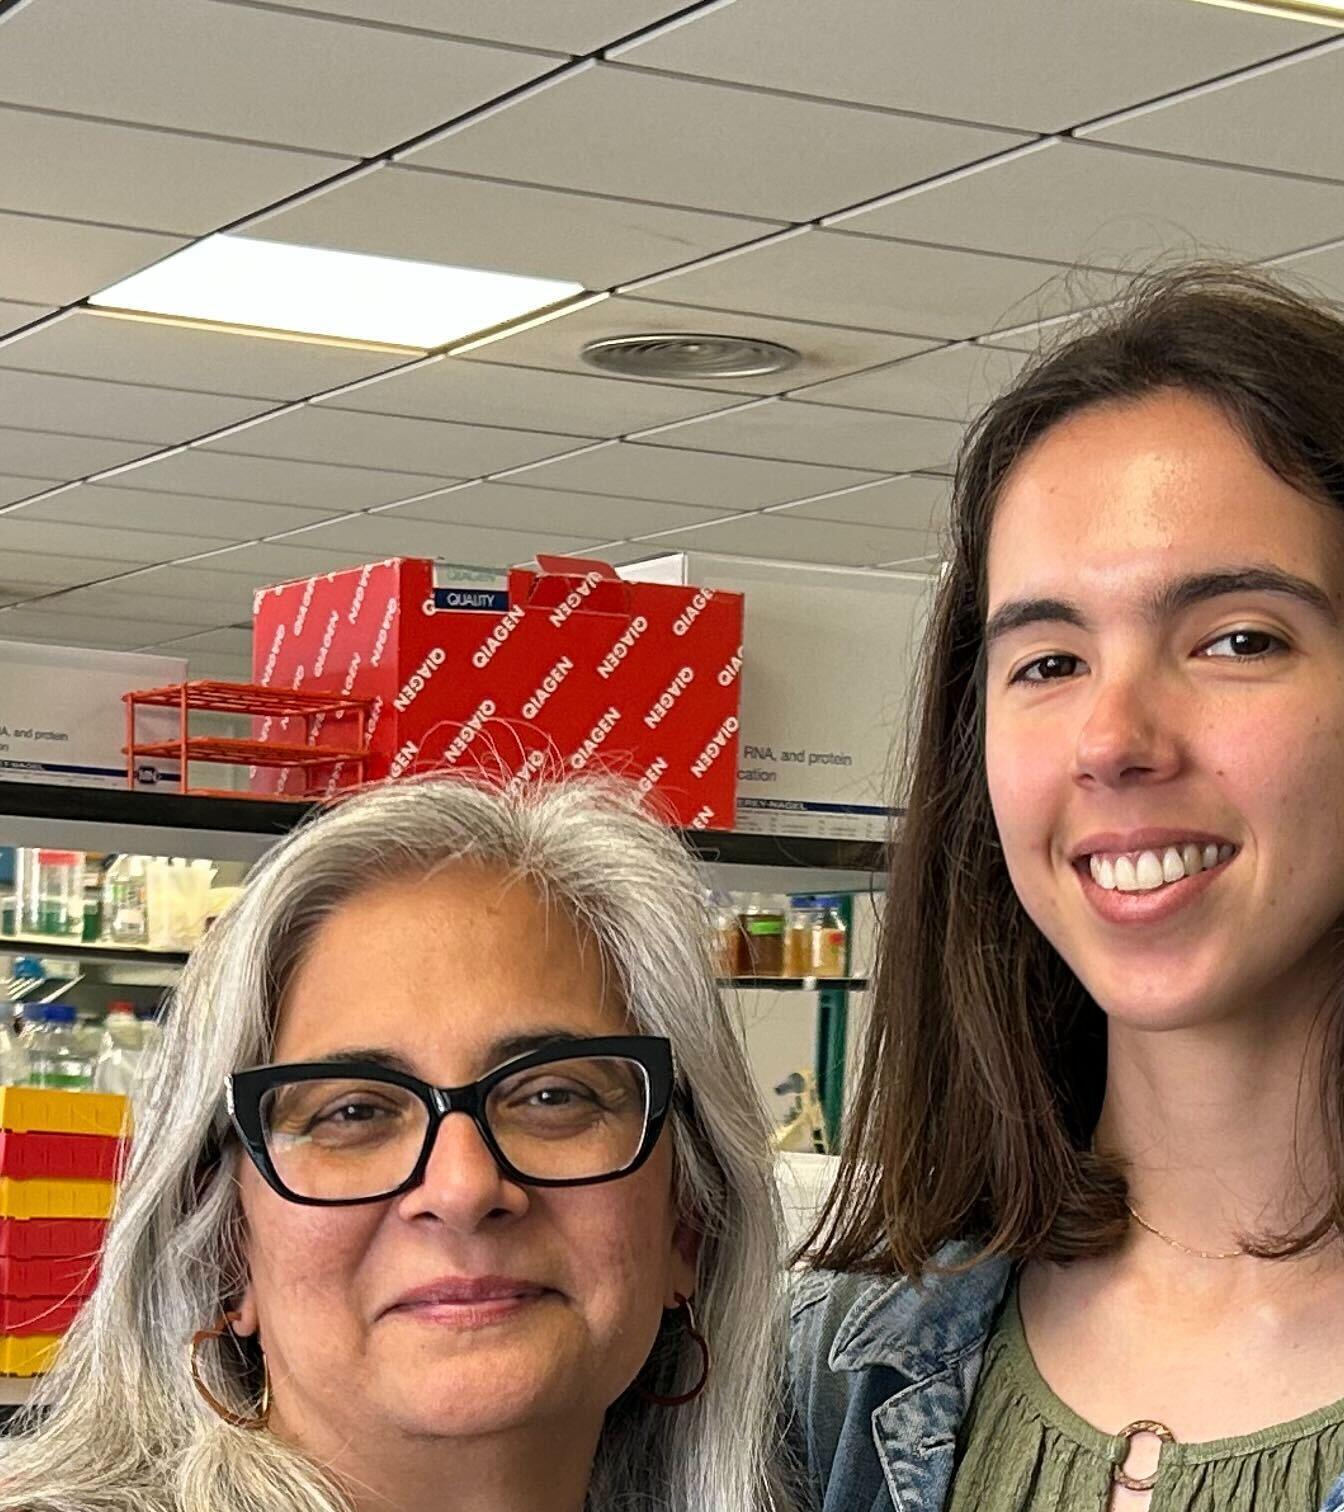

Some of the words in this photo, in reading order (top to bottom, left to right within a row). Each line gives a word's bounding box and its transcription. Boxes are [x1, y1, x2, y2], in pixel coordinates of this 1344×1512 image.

[447, 592, 495, 608] QUALITY
[472, 604, 526, 668] QIAGEN
[596, 615, 648, 679] QIAGEN
[393, 648, 446, 712] QIAGEN
[521, 656, 574, 719] QIAGEN
[644, 666, 695, 729] QIAGEN
[445, 699, 496, 763] QIAGEN
[569, 706, 622, 770] QIAGEN
[690, 716, 740, 779] QIAGEN
[743, 745, 776, 762] RNA,
[780, 749, 806, 763] and
[808, 750, 852, 766] protein
